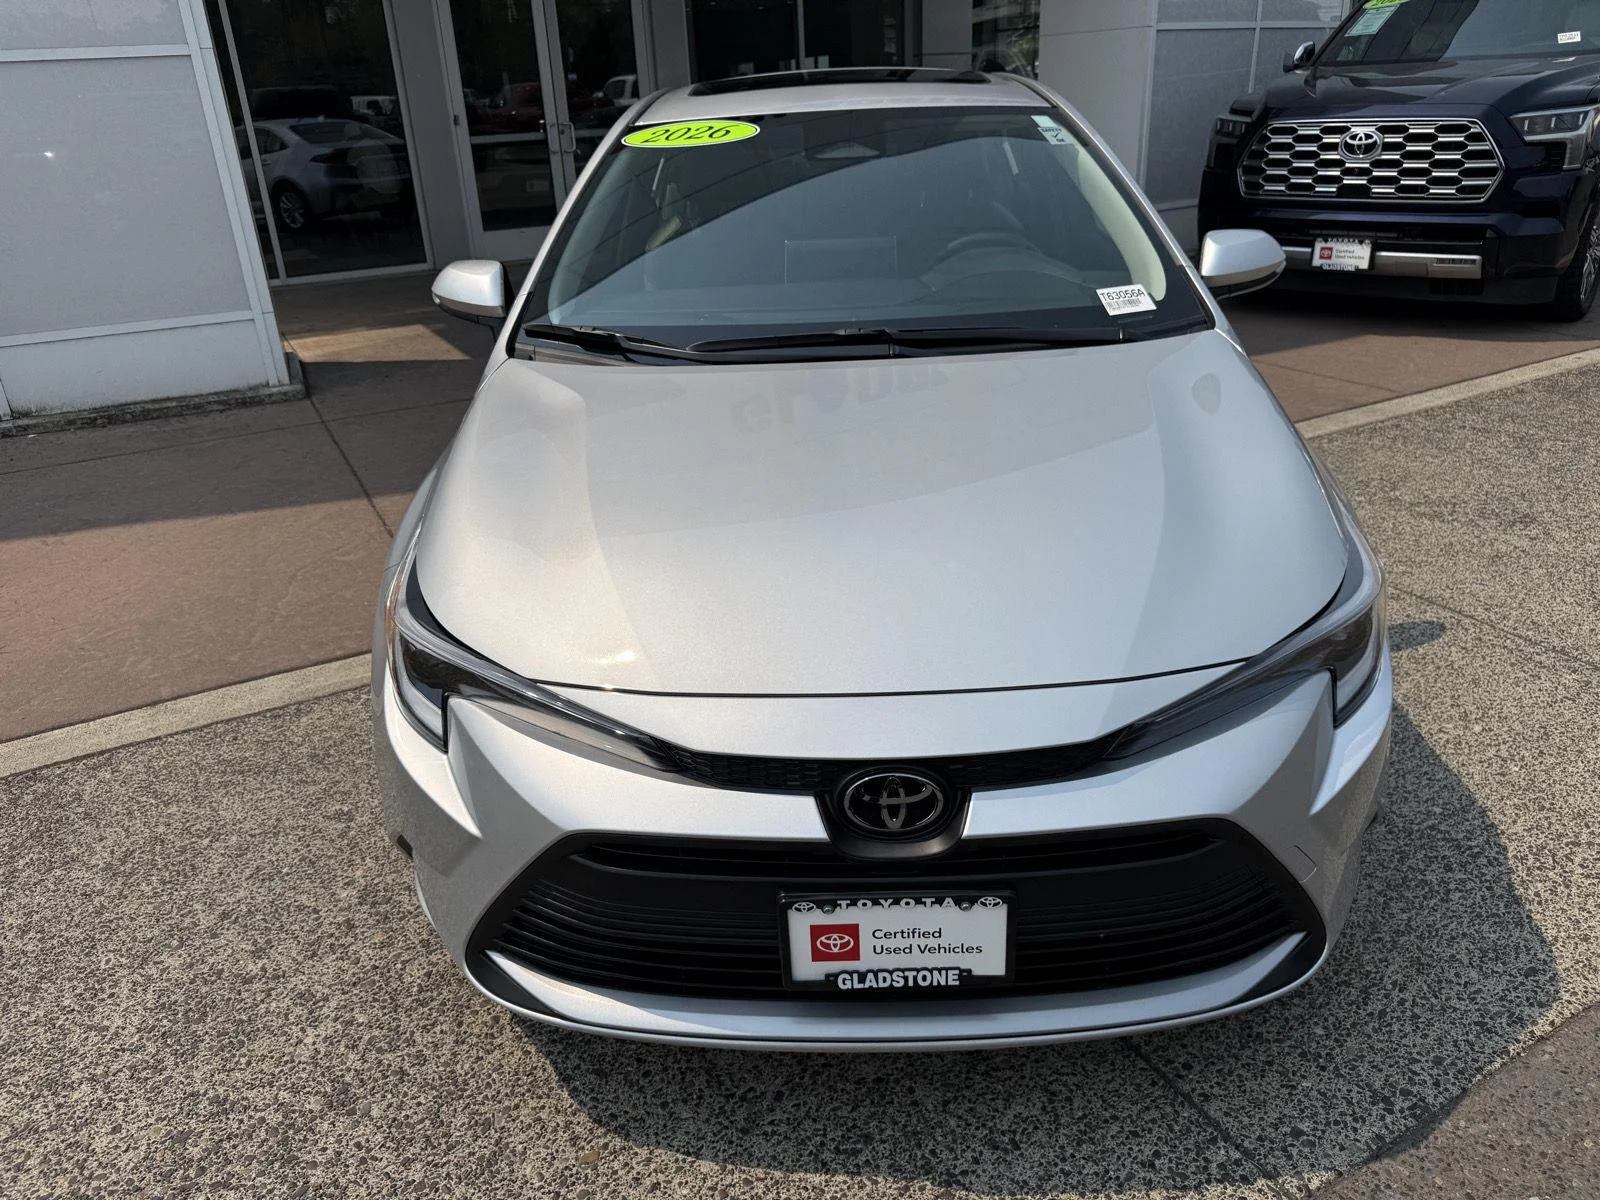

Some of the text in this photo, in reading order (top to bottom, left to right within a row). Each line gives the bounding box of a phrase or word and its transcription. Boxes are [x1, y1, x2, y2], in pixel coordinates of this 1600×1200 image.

[640, 124, 740, 144] 2026
[1100, 288, 1146, 302] T63056A
[836, 897, 959, 911] TOYOTA
[871, 927, 942, 940] Certified
[872, 943, 983, 955] Used Vehicles
[836, 969, 961, 990] GLADSTONE
